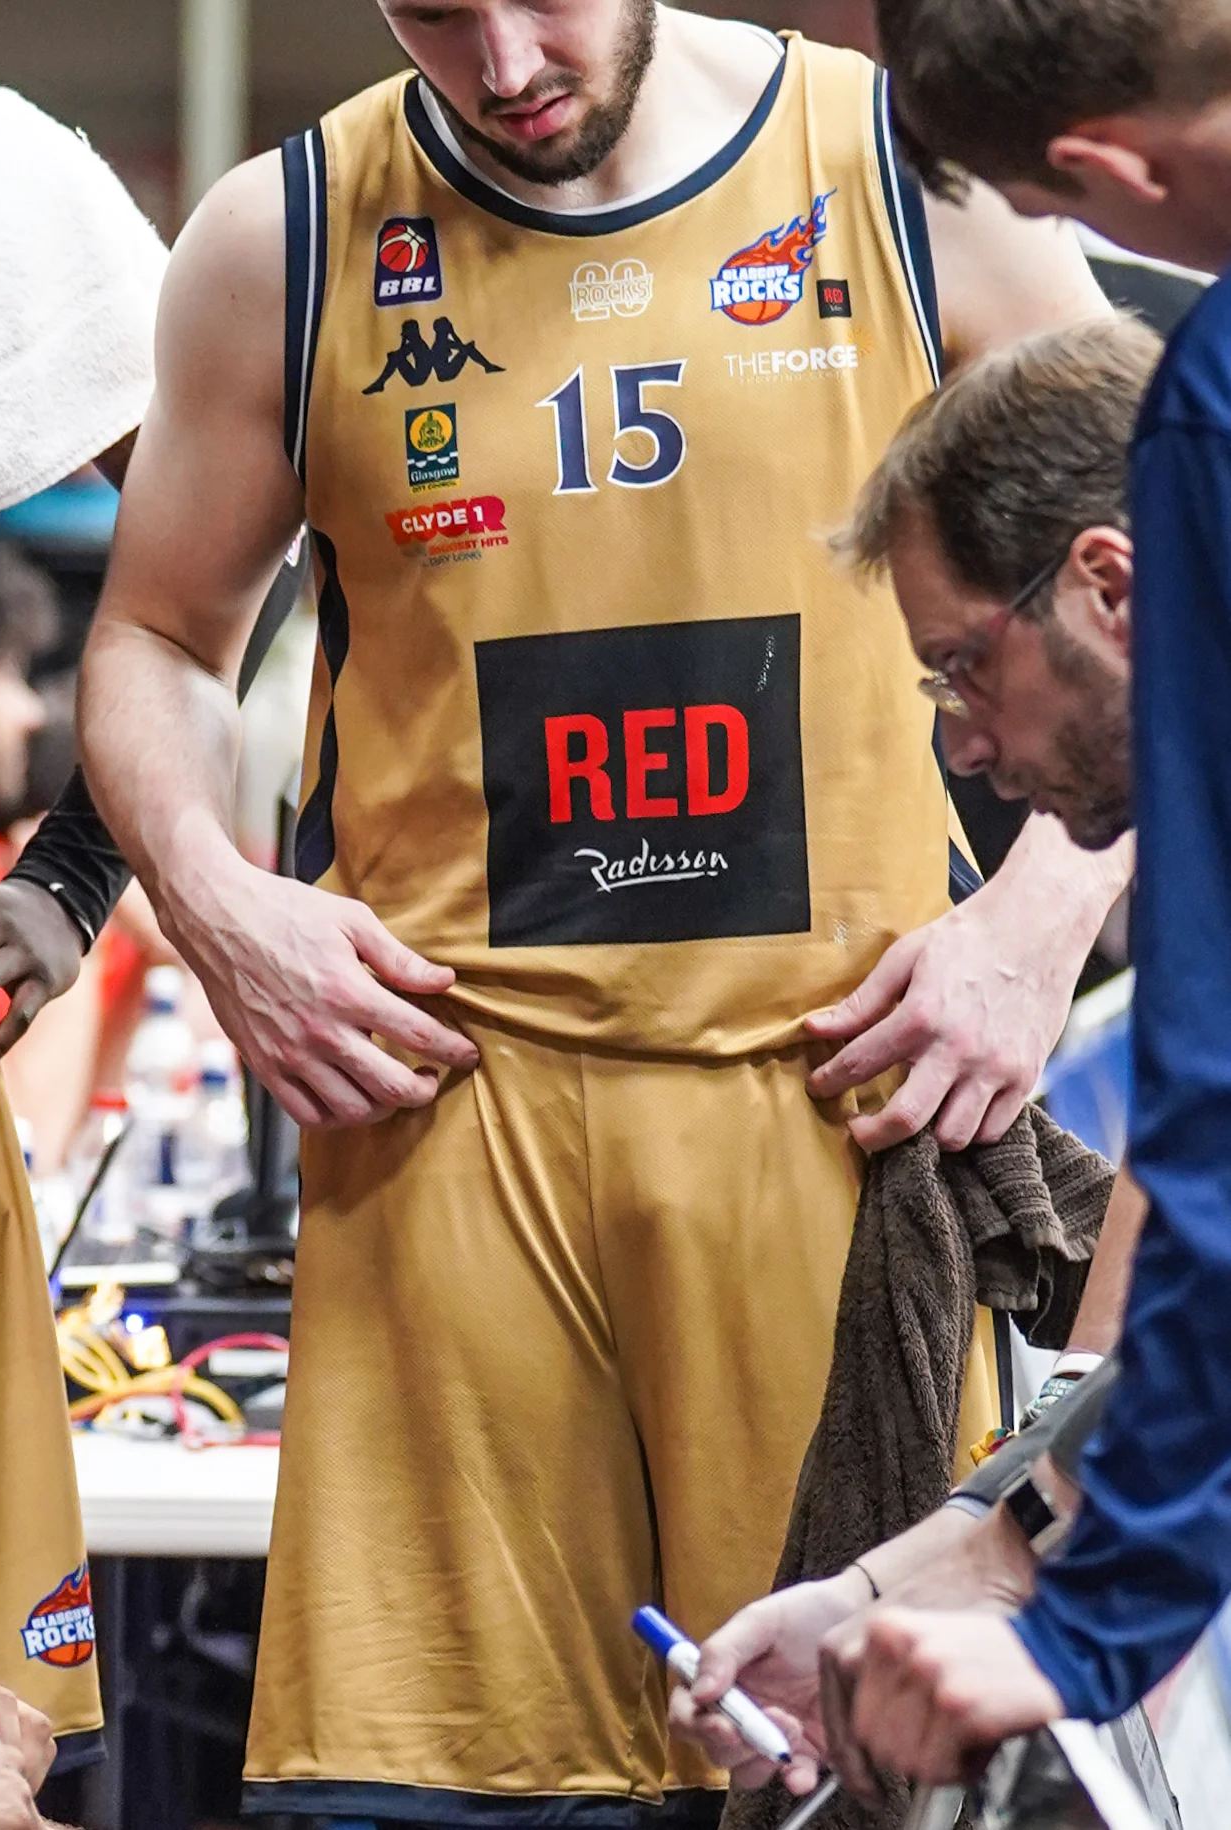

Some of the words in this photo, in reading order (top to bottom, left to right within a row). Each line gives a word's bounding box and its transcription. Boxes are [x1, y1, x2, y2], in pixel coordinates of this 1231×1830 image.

[379, 276, 437, 298] BBL
[575, 279, 649, 309] ROCKS
[713, 274, 801, 308] ROCKS
[534, 358, 687, 496] 15
[410, 467, 457, 483] Glasgow
[401, 507, 469, 534] CLYDE
[473, 505, 484, 522] 1
[481, 536, 509, 548] HITS
[544, 704, 750, 824] RED
[573, 837, 729, 893] Radisson
